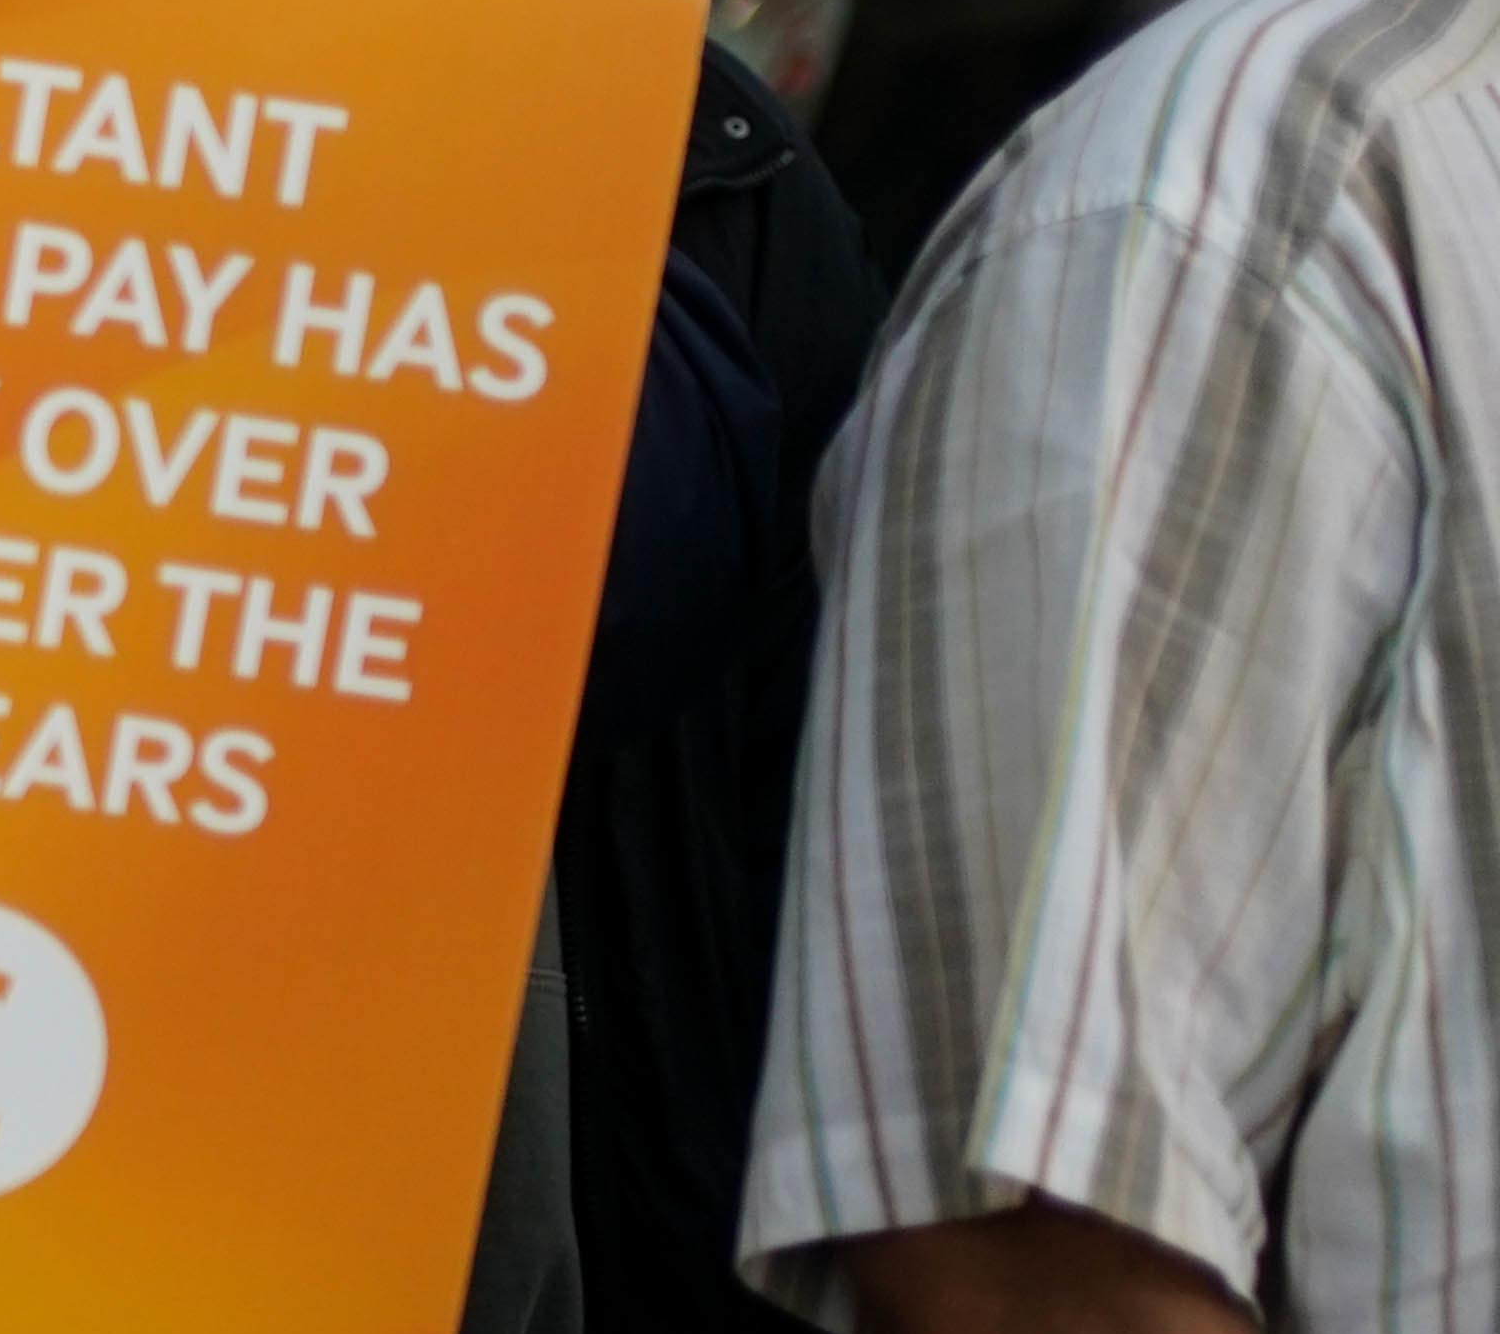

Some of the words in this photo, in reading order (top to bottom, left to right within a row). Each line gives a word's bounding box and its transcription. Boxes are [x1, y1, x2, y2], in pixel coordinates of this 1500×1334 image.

[2, 221, 254, 354] PAY
[273, 262, 554, 402] HAS
[19, 386, 390, 538] OVER
[158, 562, 423, 701] THE
